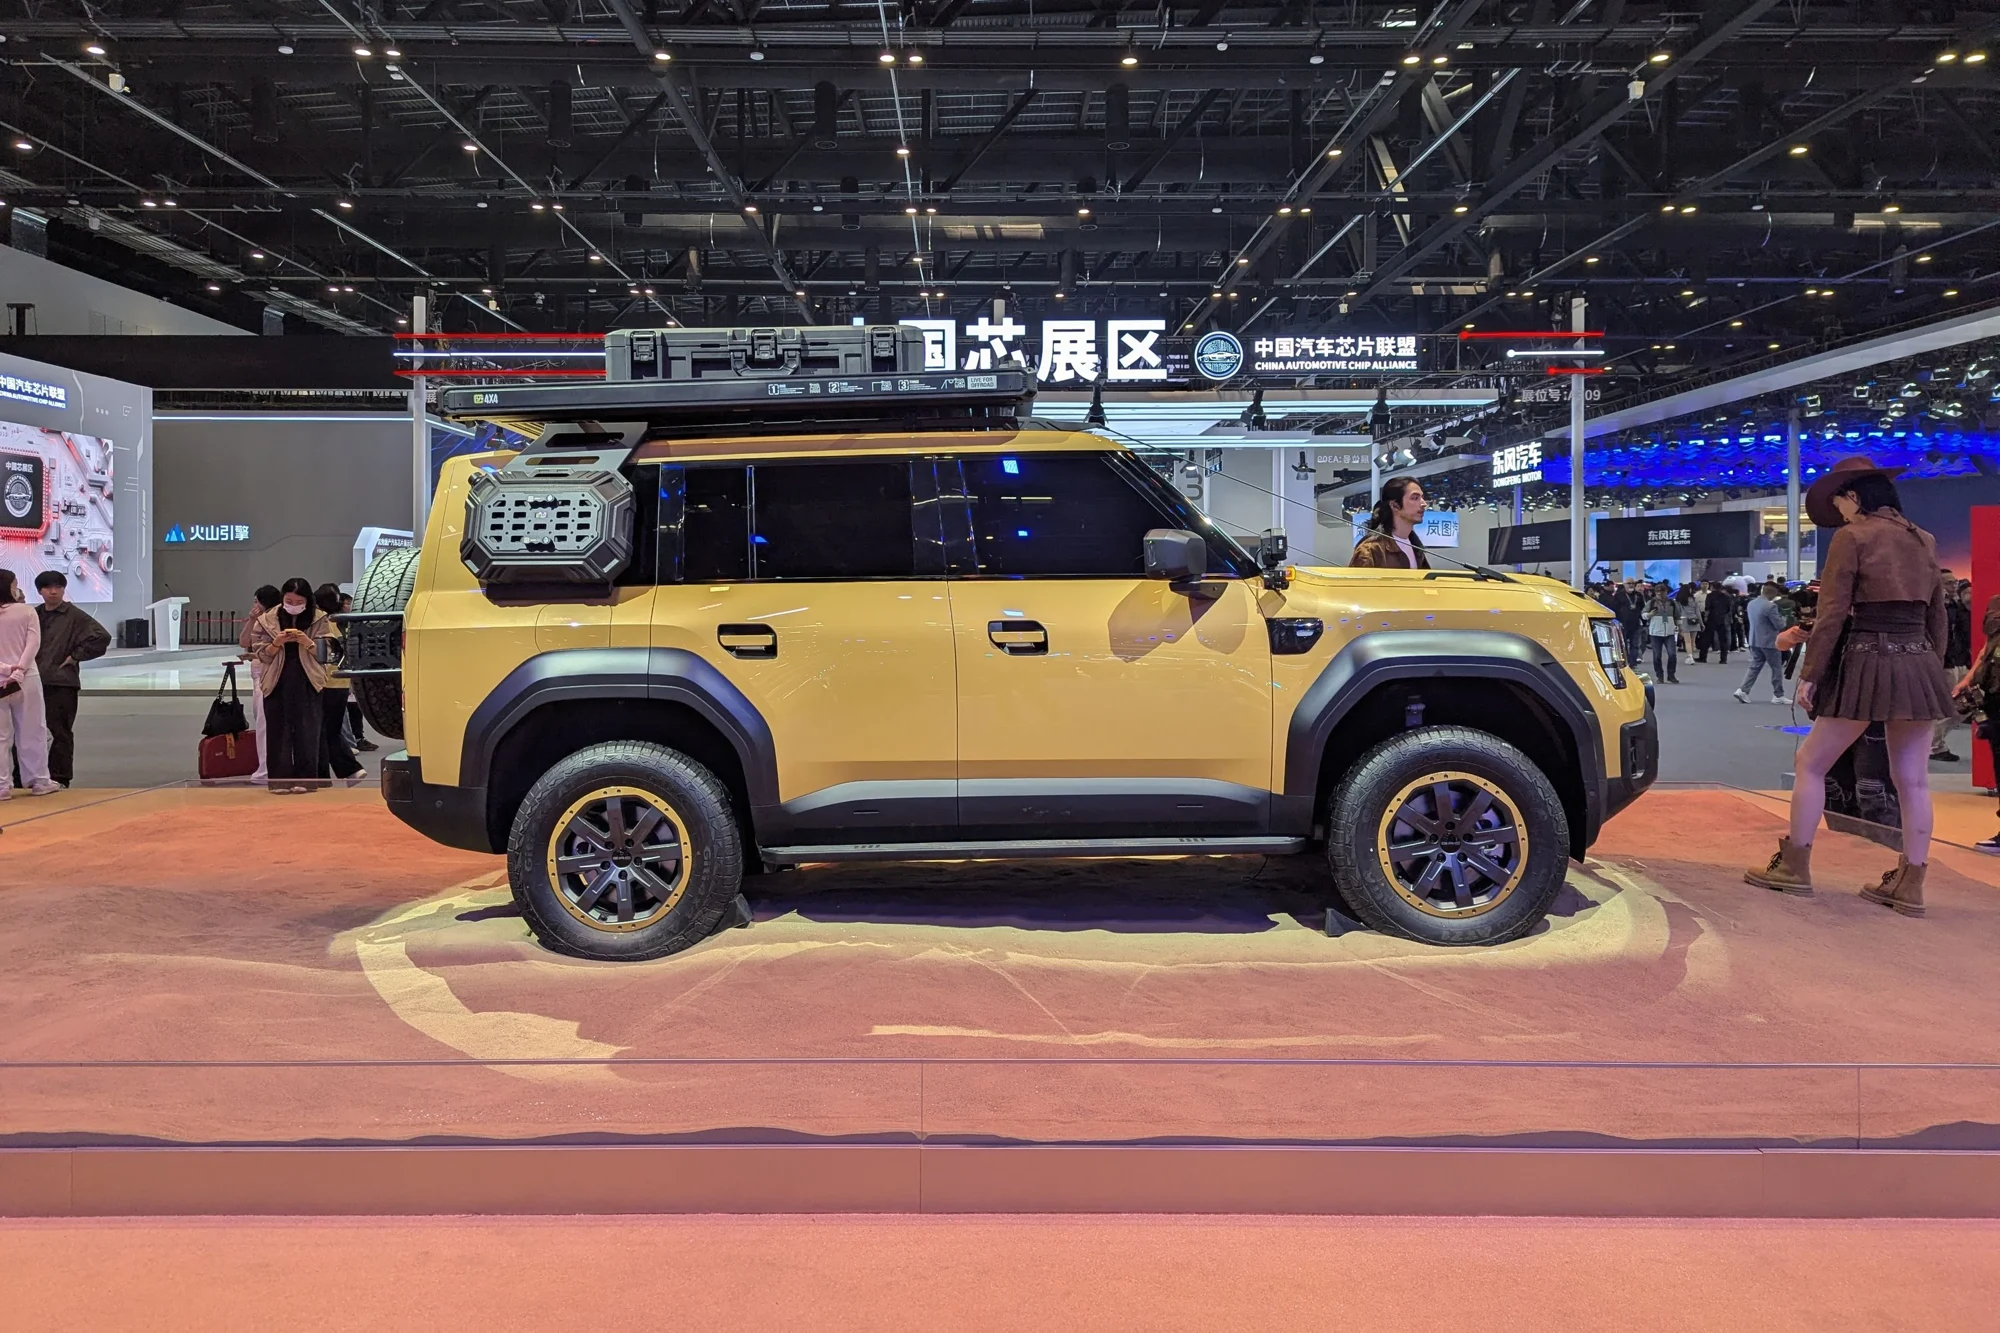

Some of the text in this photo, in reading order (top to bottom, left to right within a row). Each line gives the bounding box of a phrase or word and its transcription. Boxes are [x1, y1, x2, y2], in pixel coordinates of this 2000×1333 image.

[852, 317, 1168, 382] 国芯展区
[1254, 336, 1417, 358] 中国汽车芯片联盟
[1254, 360, 1418, 371] CHINA AUTOMOTIVE CHIP ALLIANCE
[0, 374, 66, 401] 中国汽车芯片联盟
[1522, 389, 1601, 402] 展位号:09
[484, 394, 498, 403] 4X4
[1492, 442, 1542, 475] 东风汽车
[1493, 470, 1542, 488] DONGFENG MOTOR
[189, 524, 249, 541] 火山引擎
[1648, 529, 1691, 541] 东风汽车
